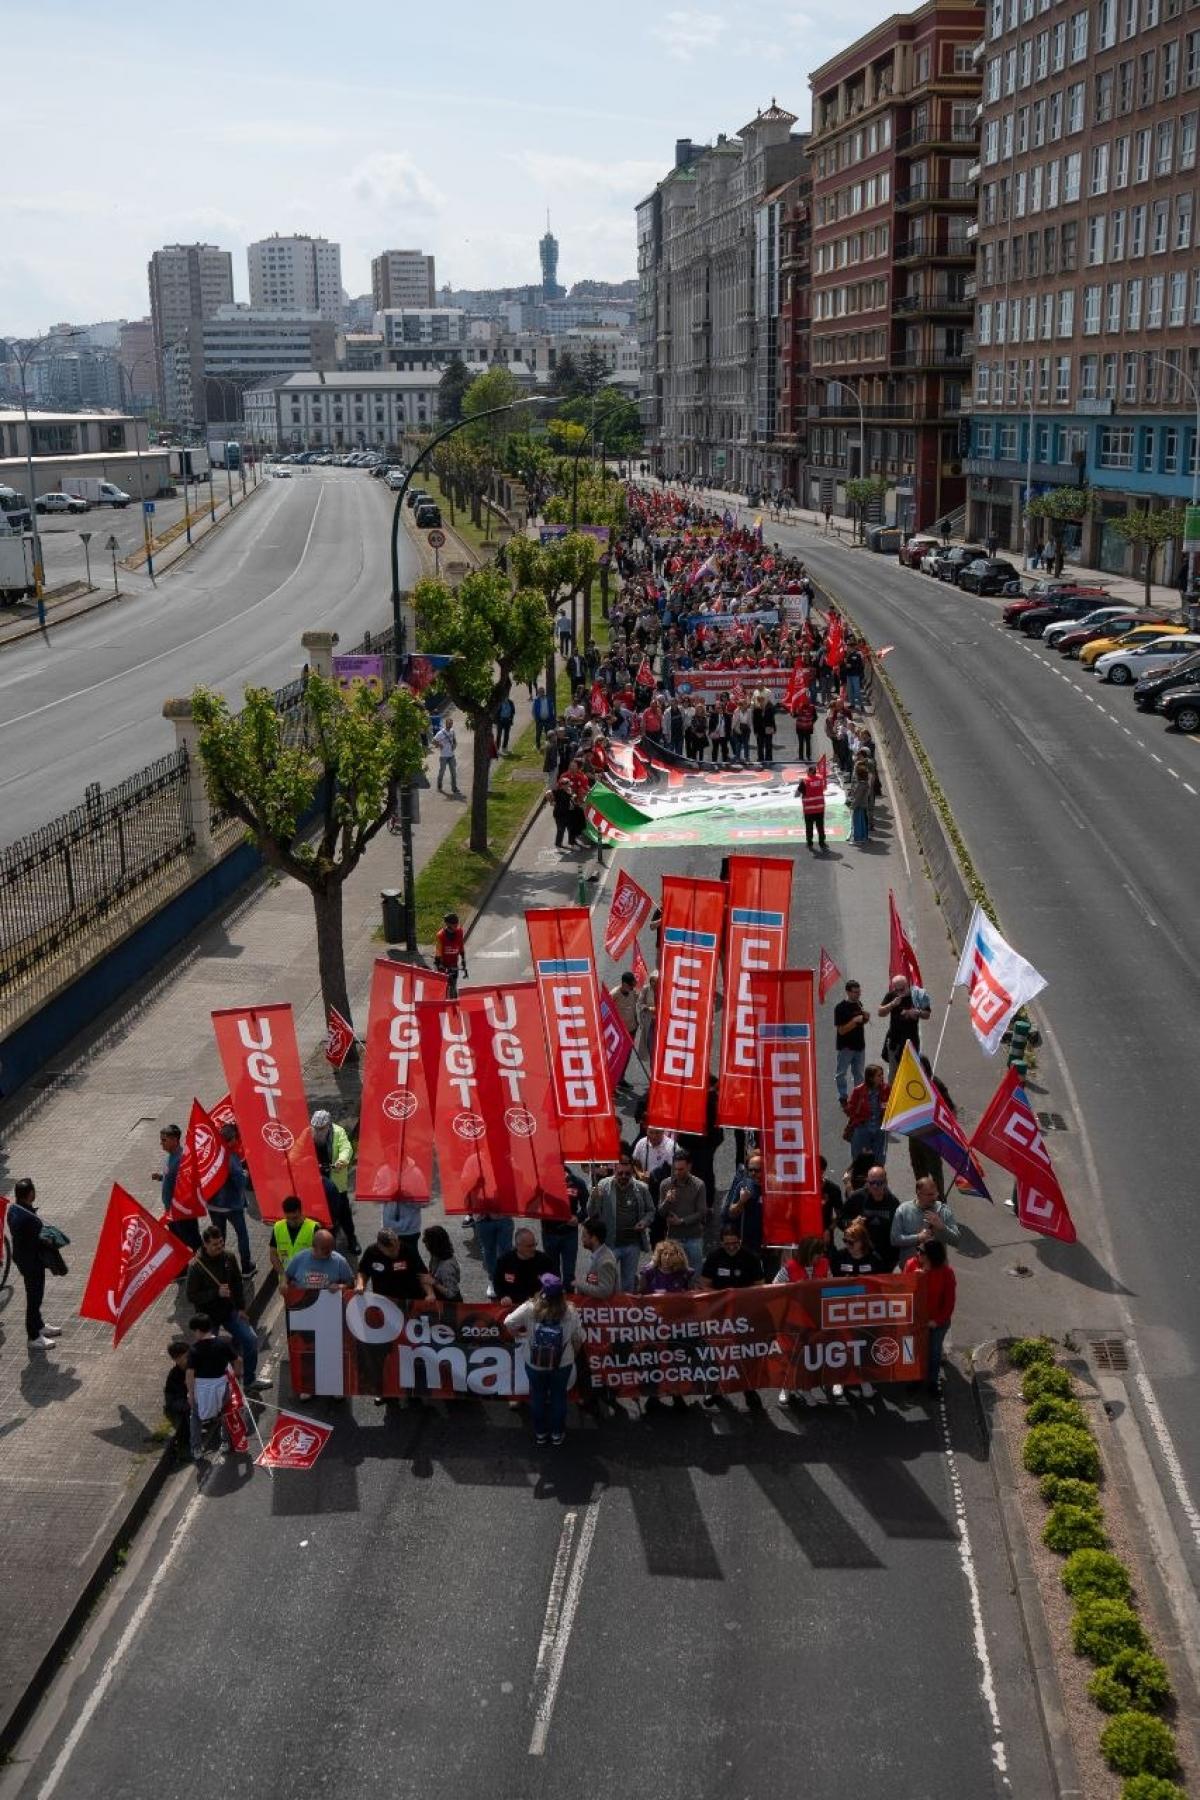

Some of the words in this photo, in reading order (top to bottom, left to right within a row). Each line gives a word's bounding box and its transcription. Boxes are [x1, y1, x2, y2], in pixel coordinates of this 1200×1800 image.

[389, 975, 424, 1085] UGT
[438, 1012, 477, 1108] UGT
[484, 995, 526, 1102] UGT
[552, 986, 598, 1107] CCOO
[664, 955, 702, 1078] CCOO
[238, 1018, 282, 1118] UGT
[770, 1052, 807, 1184] CCOO
[289, 1289, 404, 1396] 1º
[405, 1316, 455, 1344] de
[462, 1326, 499, 1337] 2026
[590, 1349, 692, 1370] SALARIOS,
[697, 1339, 783, 1362] VIVENDA
[606, 1316, 755, 1344] TRINCHEIRAS.
[804, 1340, 867, 1371] UGT
[828, 1300, 907, 1322] CCOO
[398, 1343, 577, 1396] mai
[591, 1374, 602, 1388] E
[607, 1364, 740, 1386] DEMOCRACIA
